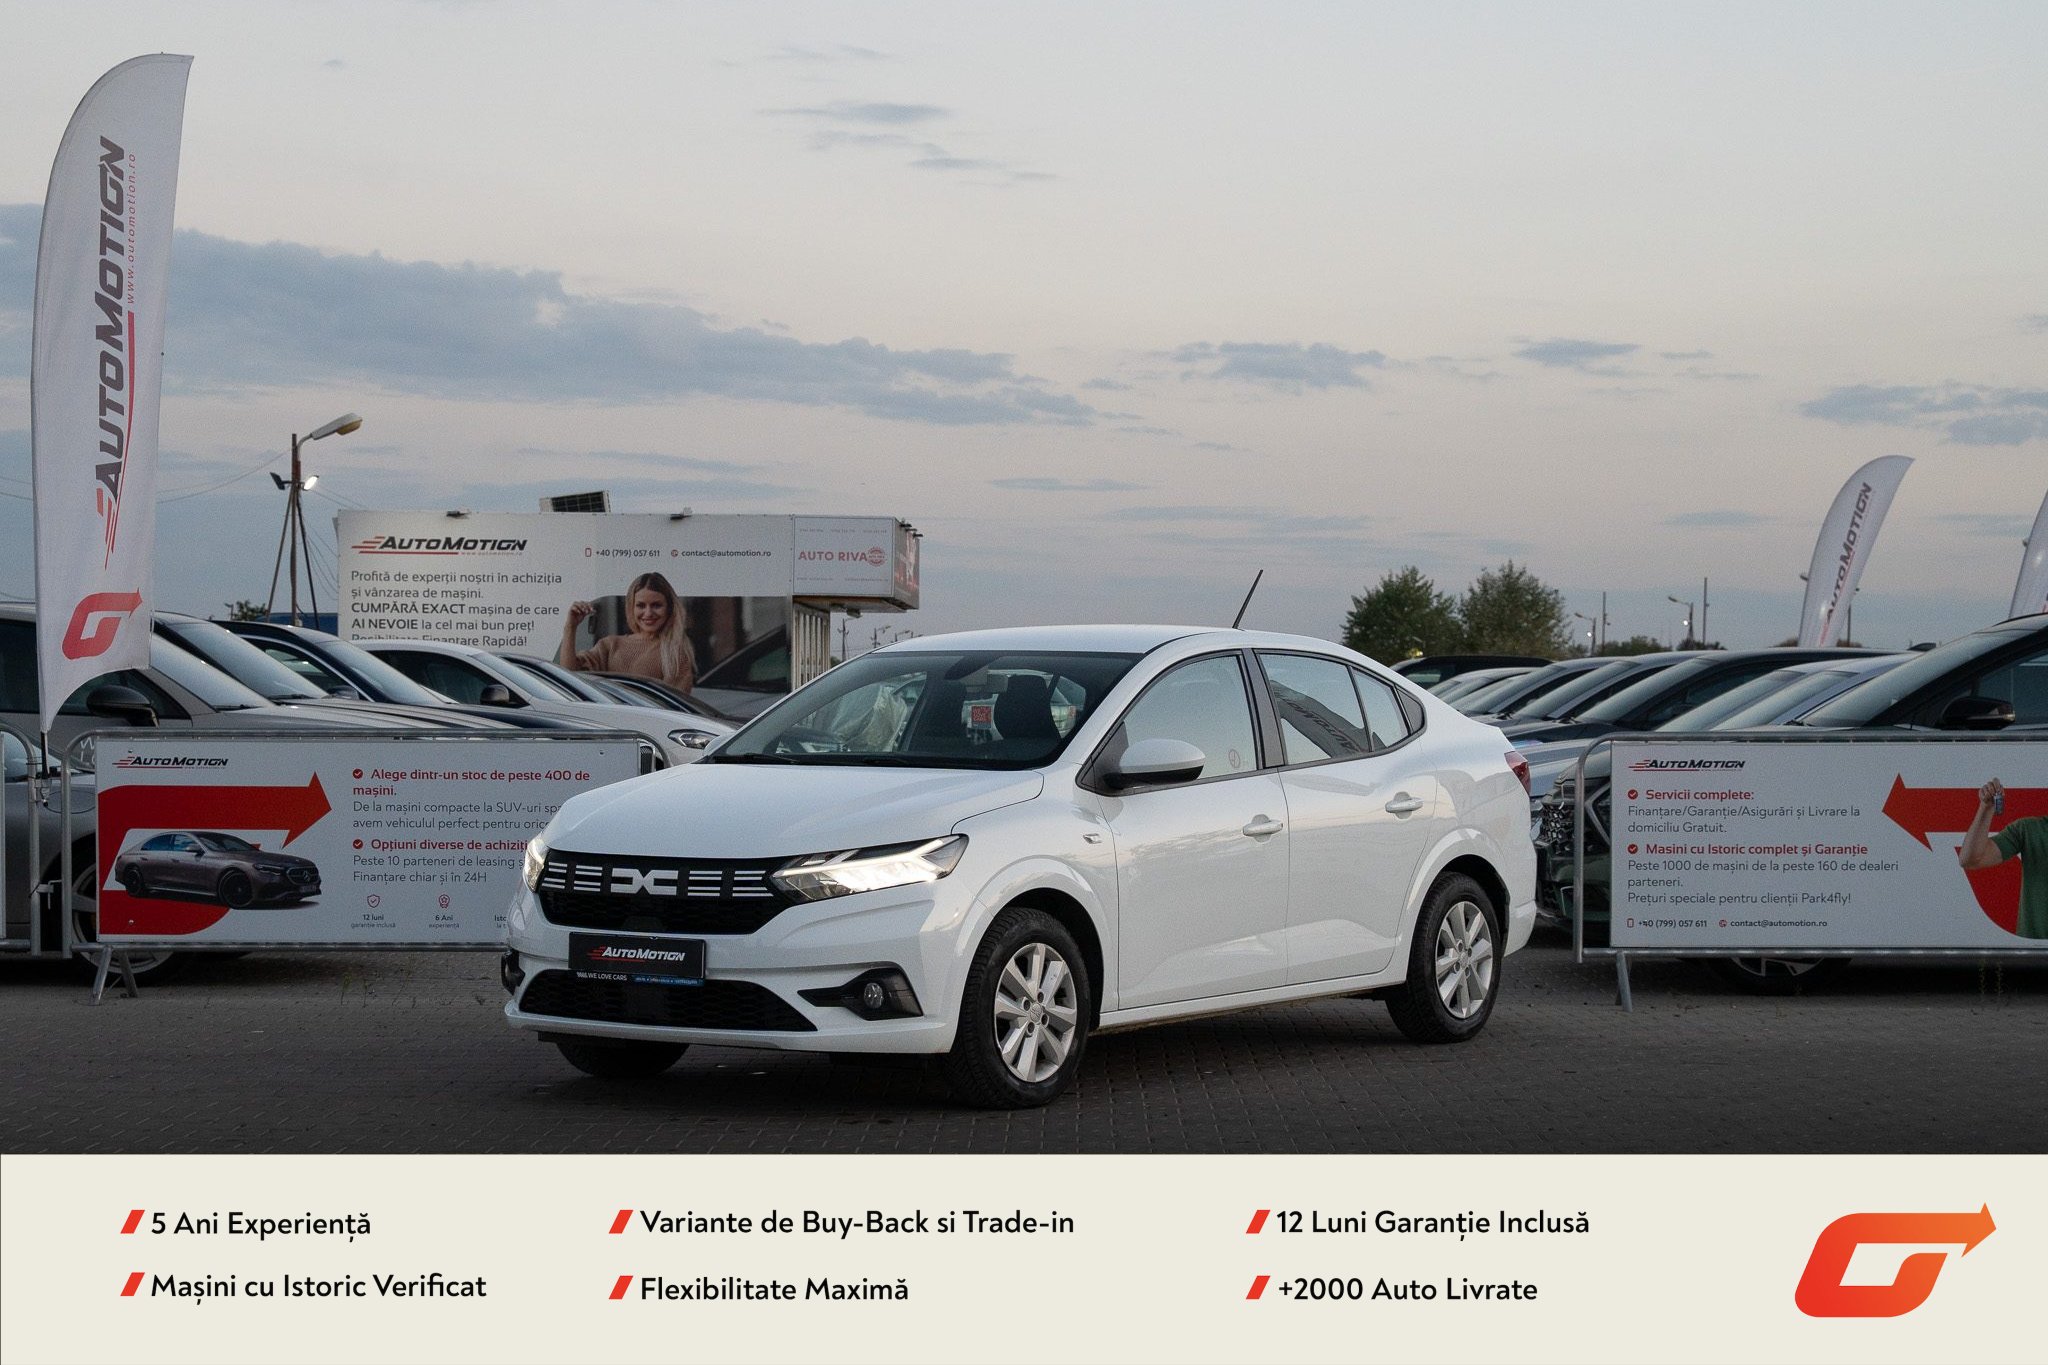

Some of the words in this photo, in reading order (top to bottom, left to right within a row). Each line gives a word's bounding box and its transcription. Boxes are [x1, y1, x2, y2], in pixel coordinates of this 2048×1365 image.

[127, 153, 137, 304] www.automotion.ro
[596, 549, 610, 557] +40
[612, 549, 632, 558] (799)
[633, 549, 647, 557] 057
[649, 549, 660, 557] 611
[681, 549, 772, 558] contact@automotion.ro
[798, 551, 834, 561] AUTO
[838, 551, 868, 562] RIVA
[351, 570, 390, 582] Profită
[394, 571, 408, 582] de
[412, 571, 457, 586] experții
[460, 571, 494, 585] noștri
[511, 572, 562, 586] achiziția
[351, 587, 361, 599] și
[364, 587, 419, 598] vânzarea
[422, 587, 437, 598] de
[441, 587, 484, 600] mașini.
[351, 601, 418, 614] CUMPĂRĂ
[422, 603, 465, 615] EXACT
[468, 604, 512, 616] mașina
[515, 604, 531, 615] de
[534, 606, 560, 615] care
[351, 618, 365, 629] AI
[368, 618, 418, 630] NEVOIE
[421, 619, 432, 630] la
[435, 619, 452, 630] cel
[456, 619, 478, 631] mai
[481, 620, 504, 631] bun
[508, 620, 535, 633] preț!
[482, 635, 527, 649] Rapidă!
[371, 769, 406, 782] Alege
[410, 769, 459, 780] dintr-un
[462, 771, 487, 781] stoc
[490, 770, 505, 781] de
[508, 771, 542, 783] peste
[545, 770, 572, 781] 400
[575, 771, 590, 781] de
[353, 785, 397, 797] mașini.
[1646, 789, 1691, 800] Servicii
[1693, 789, 1754, 803] complete:
[353, 801, 369, 812] De
[372, 801, 382, 812] la
[385, 802, 421, 814] mașini
[424, 803, 480, 815] compacte
[483, 802, 493, 813] la
[496, 802, 541, 813] SUV-uri
[1797, 806, 1805, 821] și
[1808, 806, 1847, 817] Livrare
[1851, 806, 1860, 817] la
[352, 819, 383, 829] avem
[386, 818, 435, 829] vehiculul
[438, 818, 480, 830] perfect
[483, 819, 520, 830] pentru
[1627, 822, 1680, 833] domiciliu
[1682, 822, 1727, 834] Gratuit.
[371, 838, 417, 852] Opțiuni
[419, 839, 464, 850] diverse
[467, 839, 481, 850] de
[485, 839, 528, 852] achiziți
[1690, 846, 1704, 855] cu
[1708, 844, 1745, 855] Istoric
[1748, 844, 1799, 858] complet
[1801, 844, 1812, 857] și
[1815, 844, 1868, 858] Garanție
[353, 855, 385, 866] Peste
[387, 856, 400, 866] 10
[403, 856, 455, 869] parteneri
[458, 856, 472, 867] de
[475, 856, 515, 869] leasing
[1628, 860, 1659, 871] Peste
[1663, 860, 1691, 871] 1000
[1694, 860, 1709, 871] de
[1713, 860, 1749, 873] mașini
[1752, 860, 1767, 871] de
[1770, 860, 1779, 871] la
[1782, 862, 1815, 873] peste
[1818, 860, 1838, 871] 160
[1841, 860, 1856, 871] de
[1859, 860, 1899, 871] dealeri
[353, 871, 406, 885] Finanțare
[409, 871, 436, 882] chiar
[439, 871, 448, 885] și
[464, 872, 487, 882] 24H
[1628, 877, 1683, 889] parteneri.
[1628, 892, 1667, 906] Prețuri
[1670, 893, 1716, 906] speciale
[1719, 894, 1758, 906] pentru
[1760, 893, 1798, 907] clienții
[1801, 892, 1851, 906] Park4fly!
[1655, 919, 1676, 929] (799)
[1678, 919, 1693, 928] 057
[1695, 919, 1707, 928] 611
[1730, 919, 1828, 929] contact@automotion.ro
